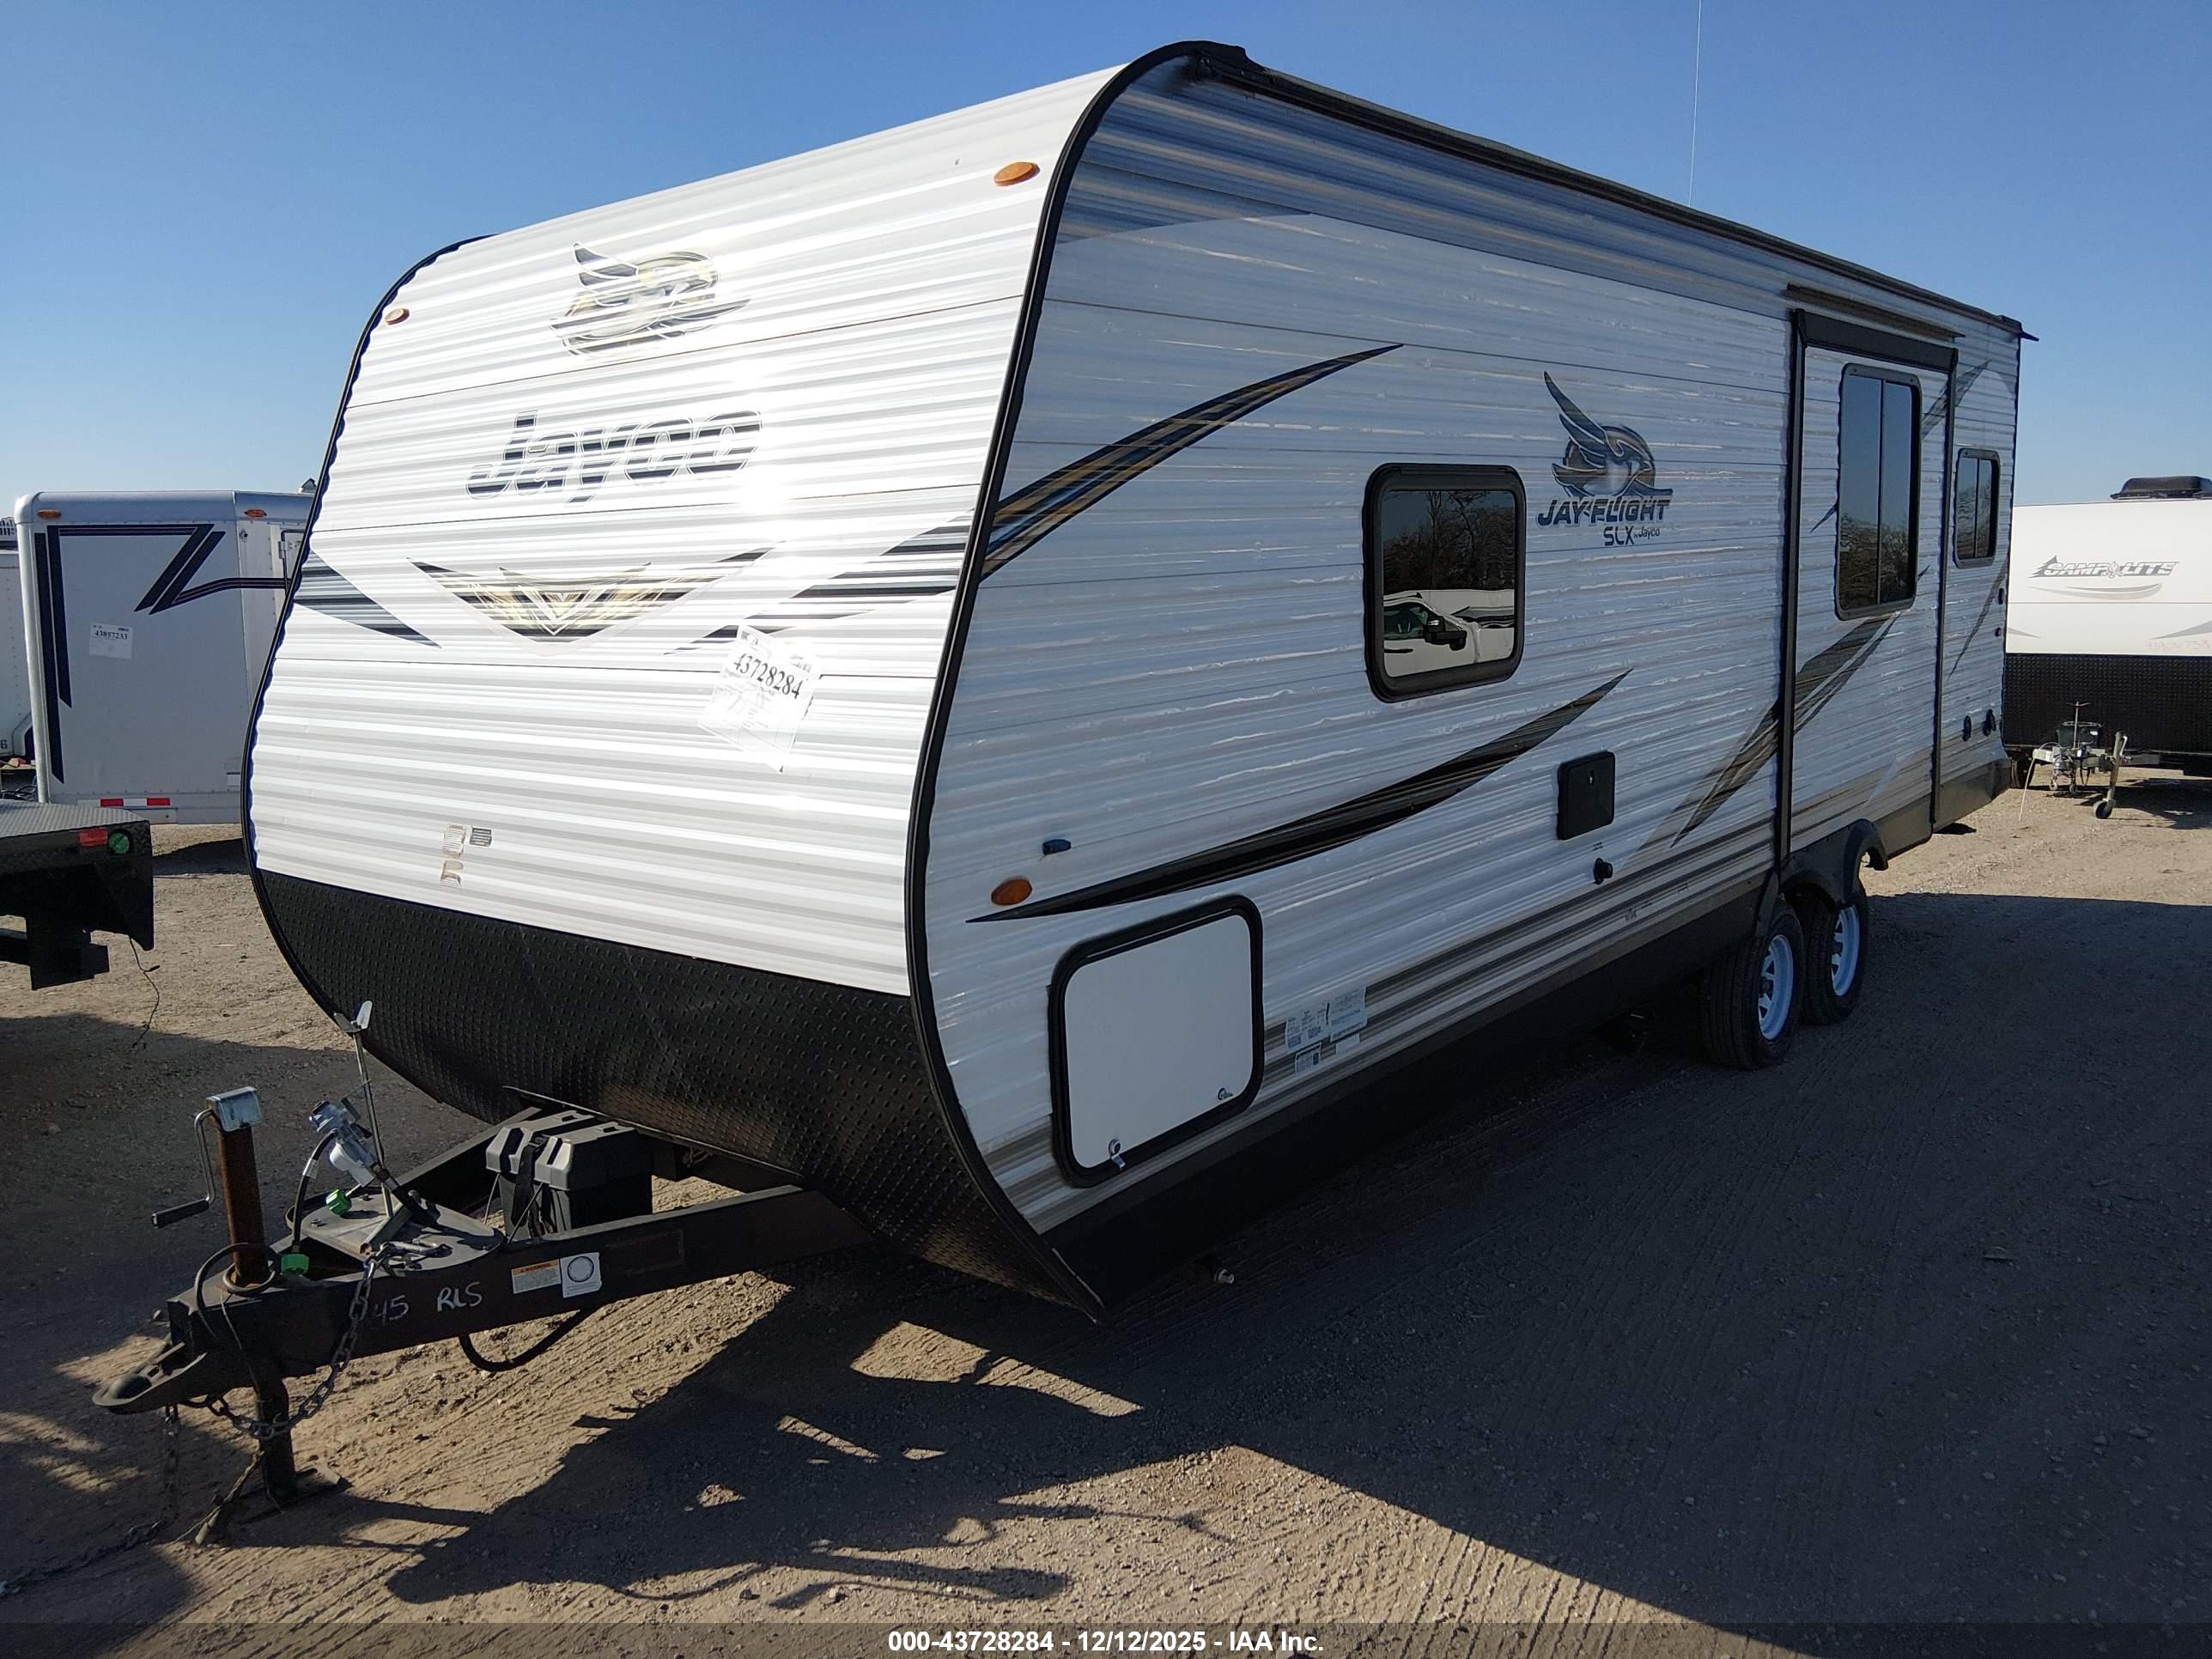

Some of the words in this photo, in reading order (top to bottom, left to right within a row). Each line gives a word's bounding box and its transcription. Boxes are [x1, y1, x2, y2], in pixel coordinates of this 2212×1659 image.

[465, 410, 763, 504] Jayco
[1603, 526, 1635, 546] SLX
[1639, 526, 1661, 540] Jayco
[733, 653, 804, 700] 43728284
[436, 1281, 483, 1312] RLS
